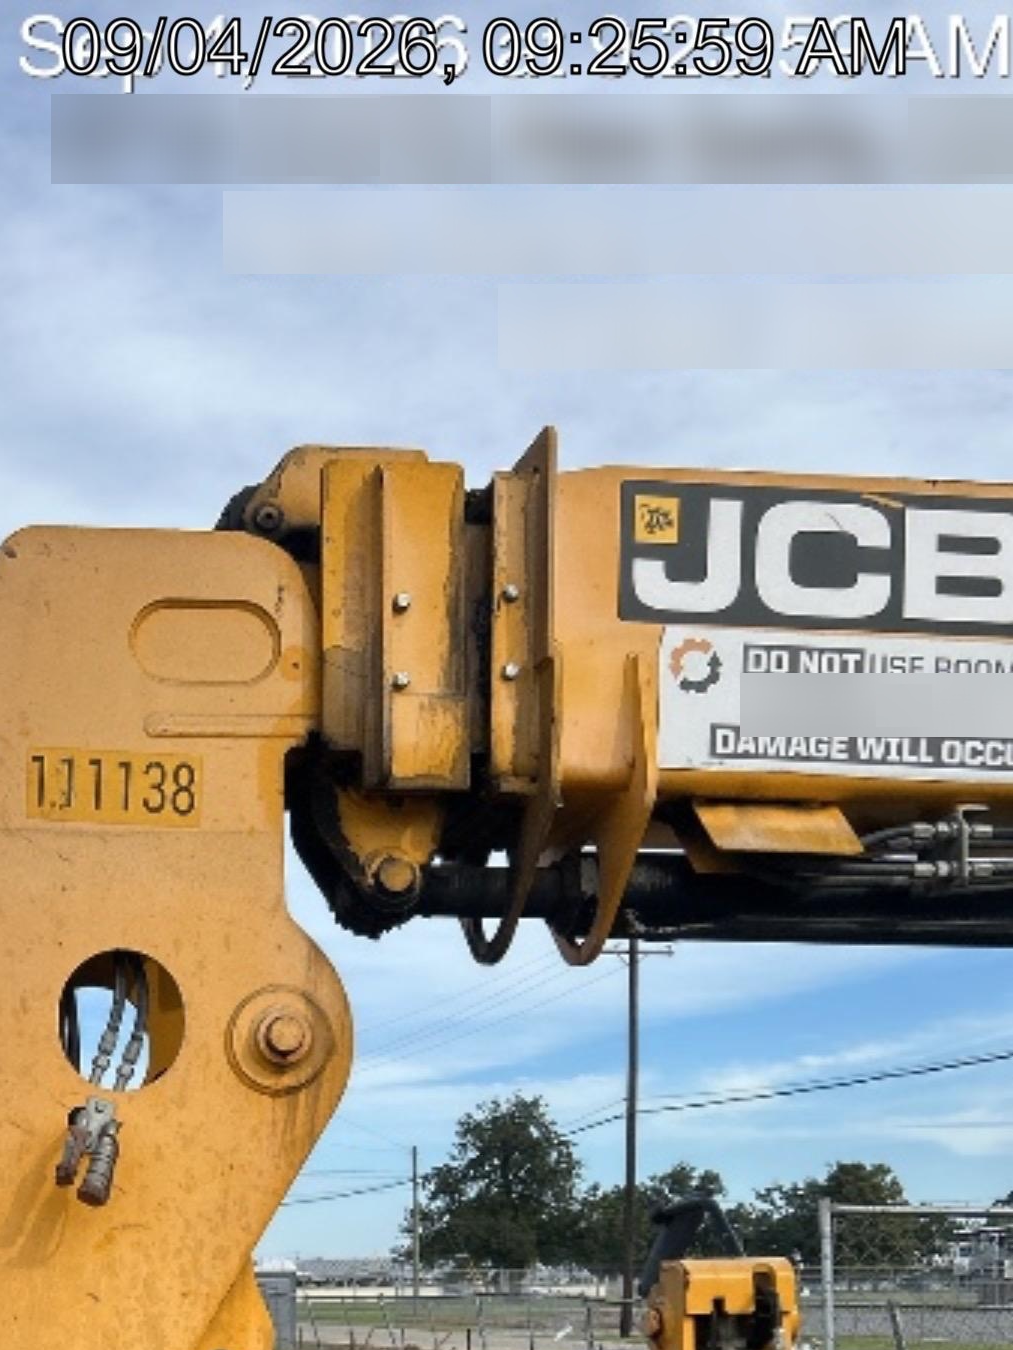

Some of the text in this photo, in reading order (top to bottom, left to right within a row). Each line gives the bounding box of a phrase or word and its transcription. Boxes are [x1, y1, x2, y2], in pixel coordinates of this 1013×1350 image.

[631, 498, 1013, 622] JCB
[747, 648, 789, 673] DO
[799, 651, 862, 673] NOT
[715, 727, 849, 760] DAMAGE
[857, 736, 934, 764] WILL
